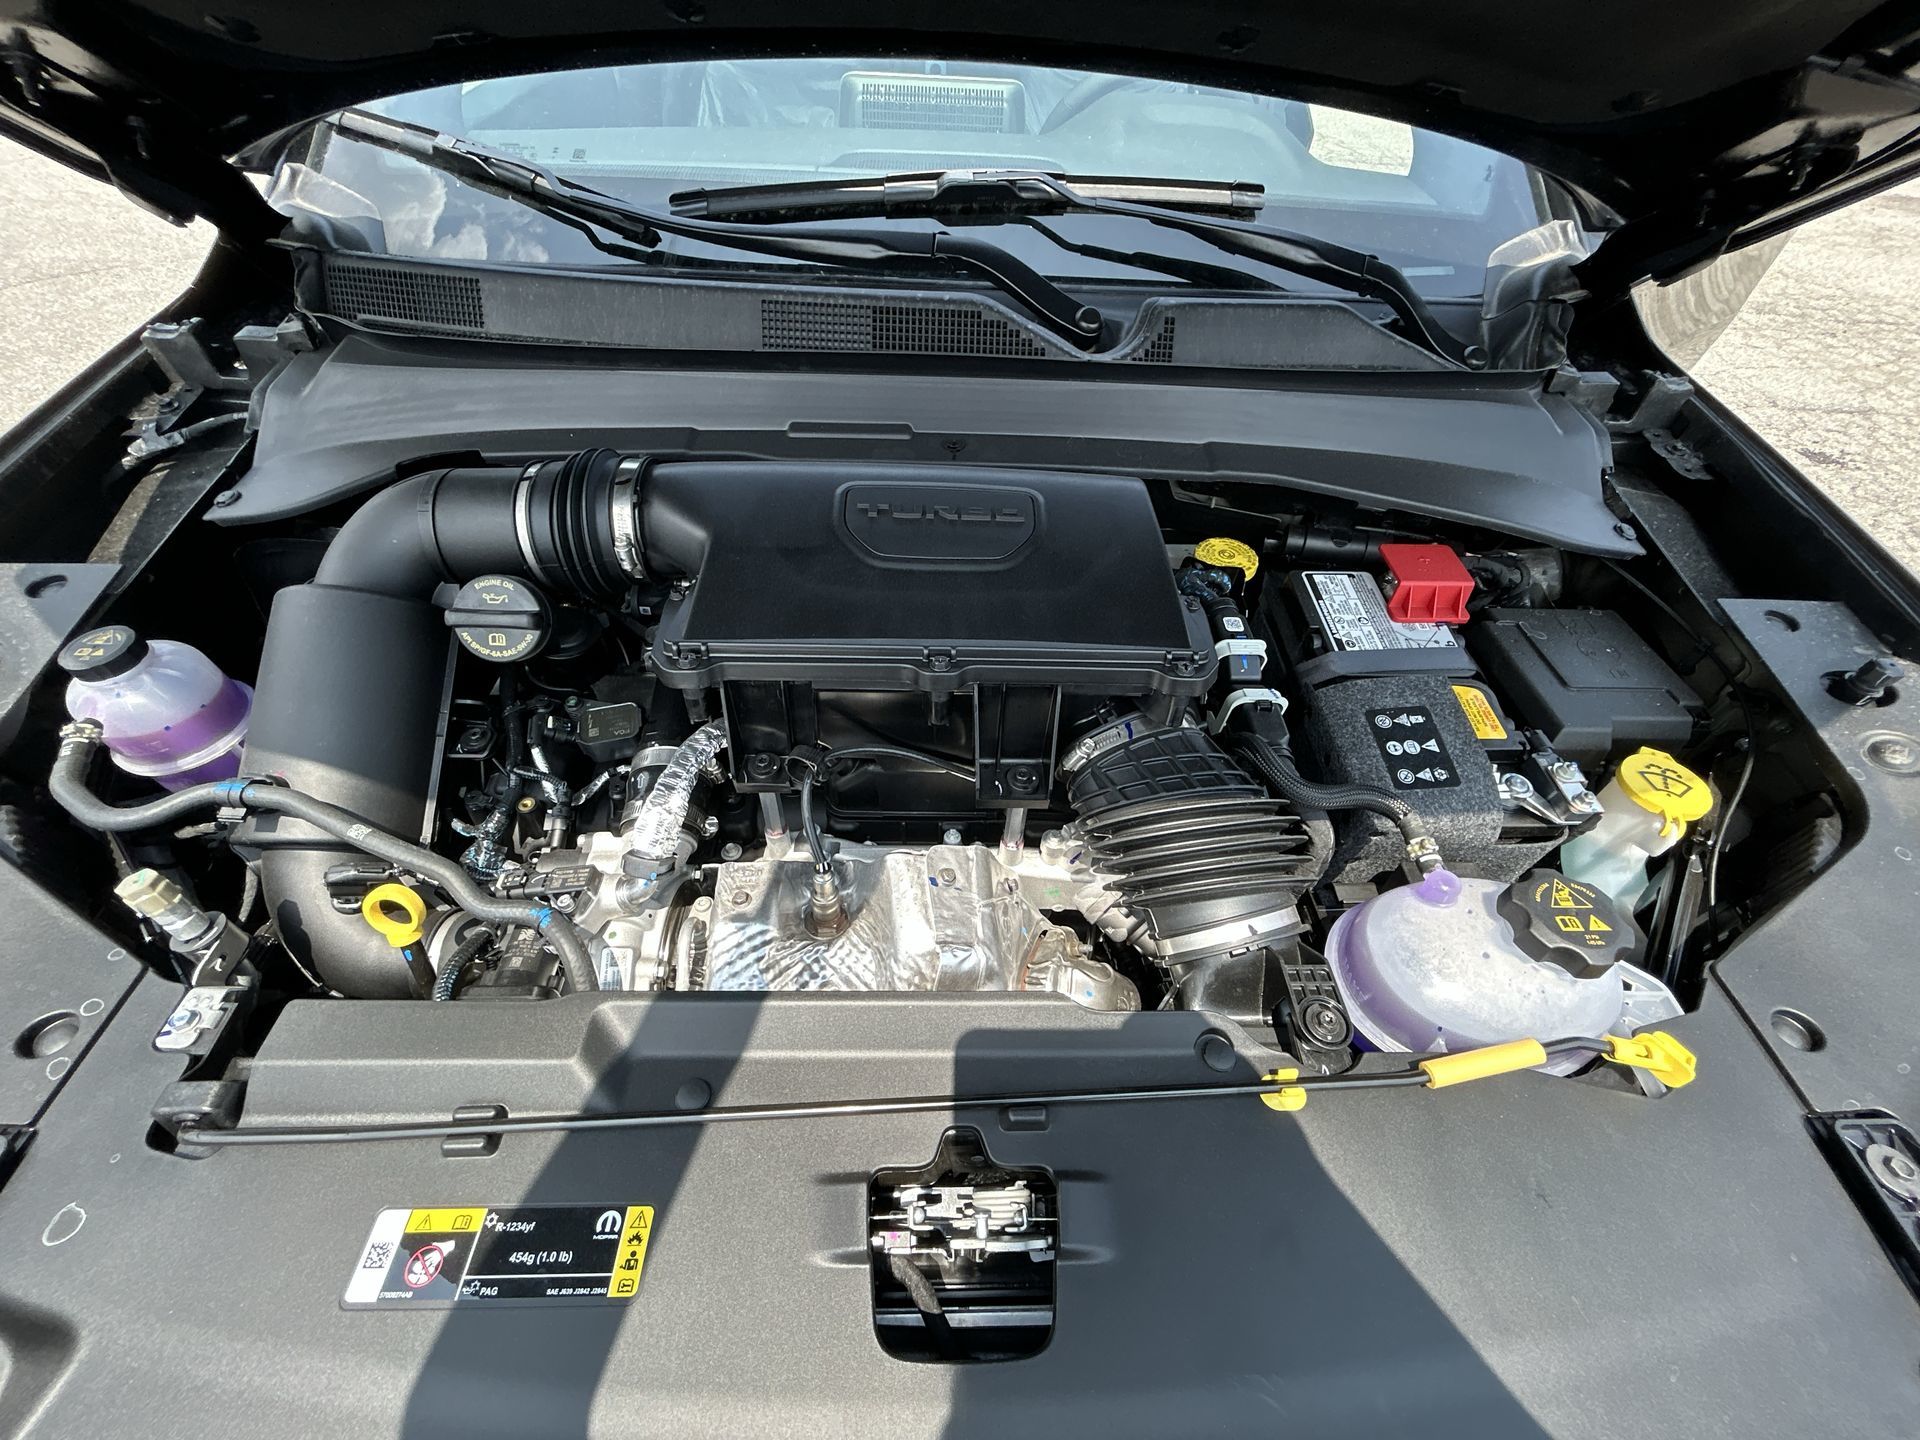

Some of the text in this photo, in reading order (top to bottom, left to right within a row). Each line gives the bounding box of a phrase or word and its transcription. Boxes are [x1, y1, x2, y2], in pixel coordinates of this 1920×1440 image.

[856, 503, 1025, 522] TURBO
[474, 579, 515, 591] ENGINE OIL
[461, 632, 473, 644] API
[495, 1221, 536, 1234] R-1234yf
[509, 1250, 573, 1265] 454g (1.0 lb)
[479, 1286, 499, 1296] PAG
